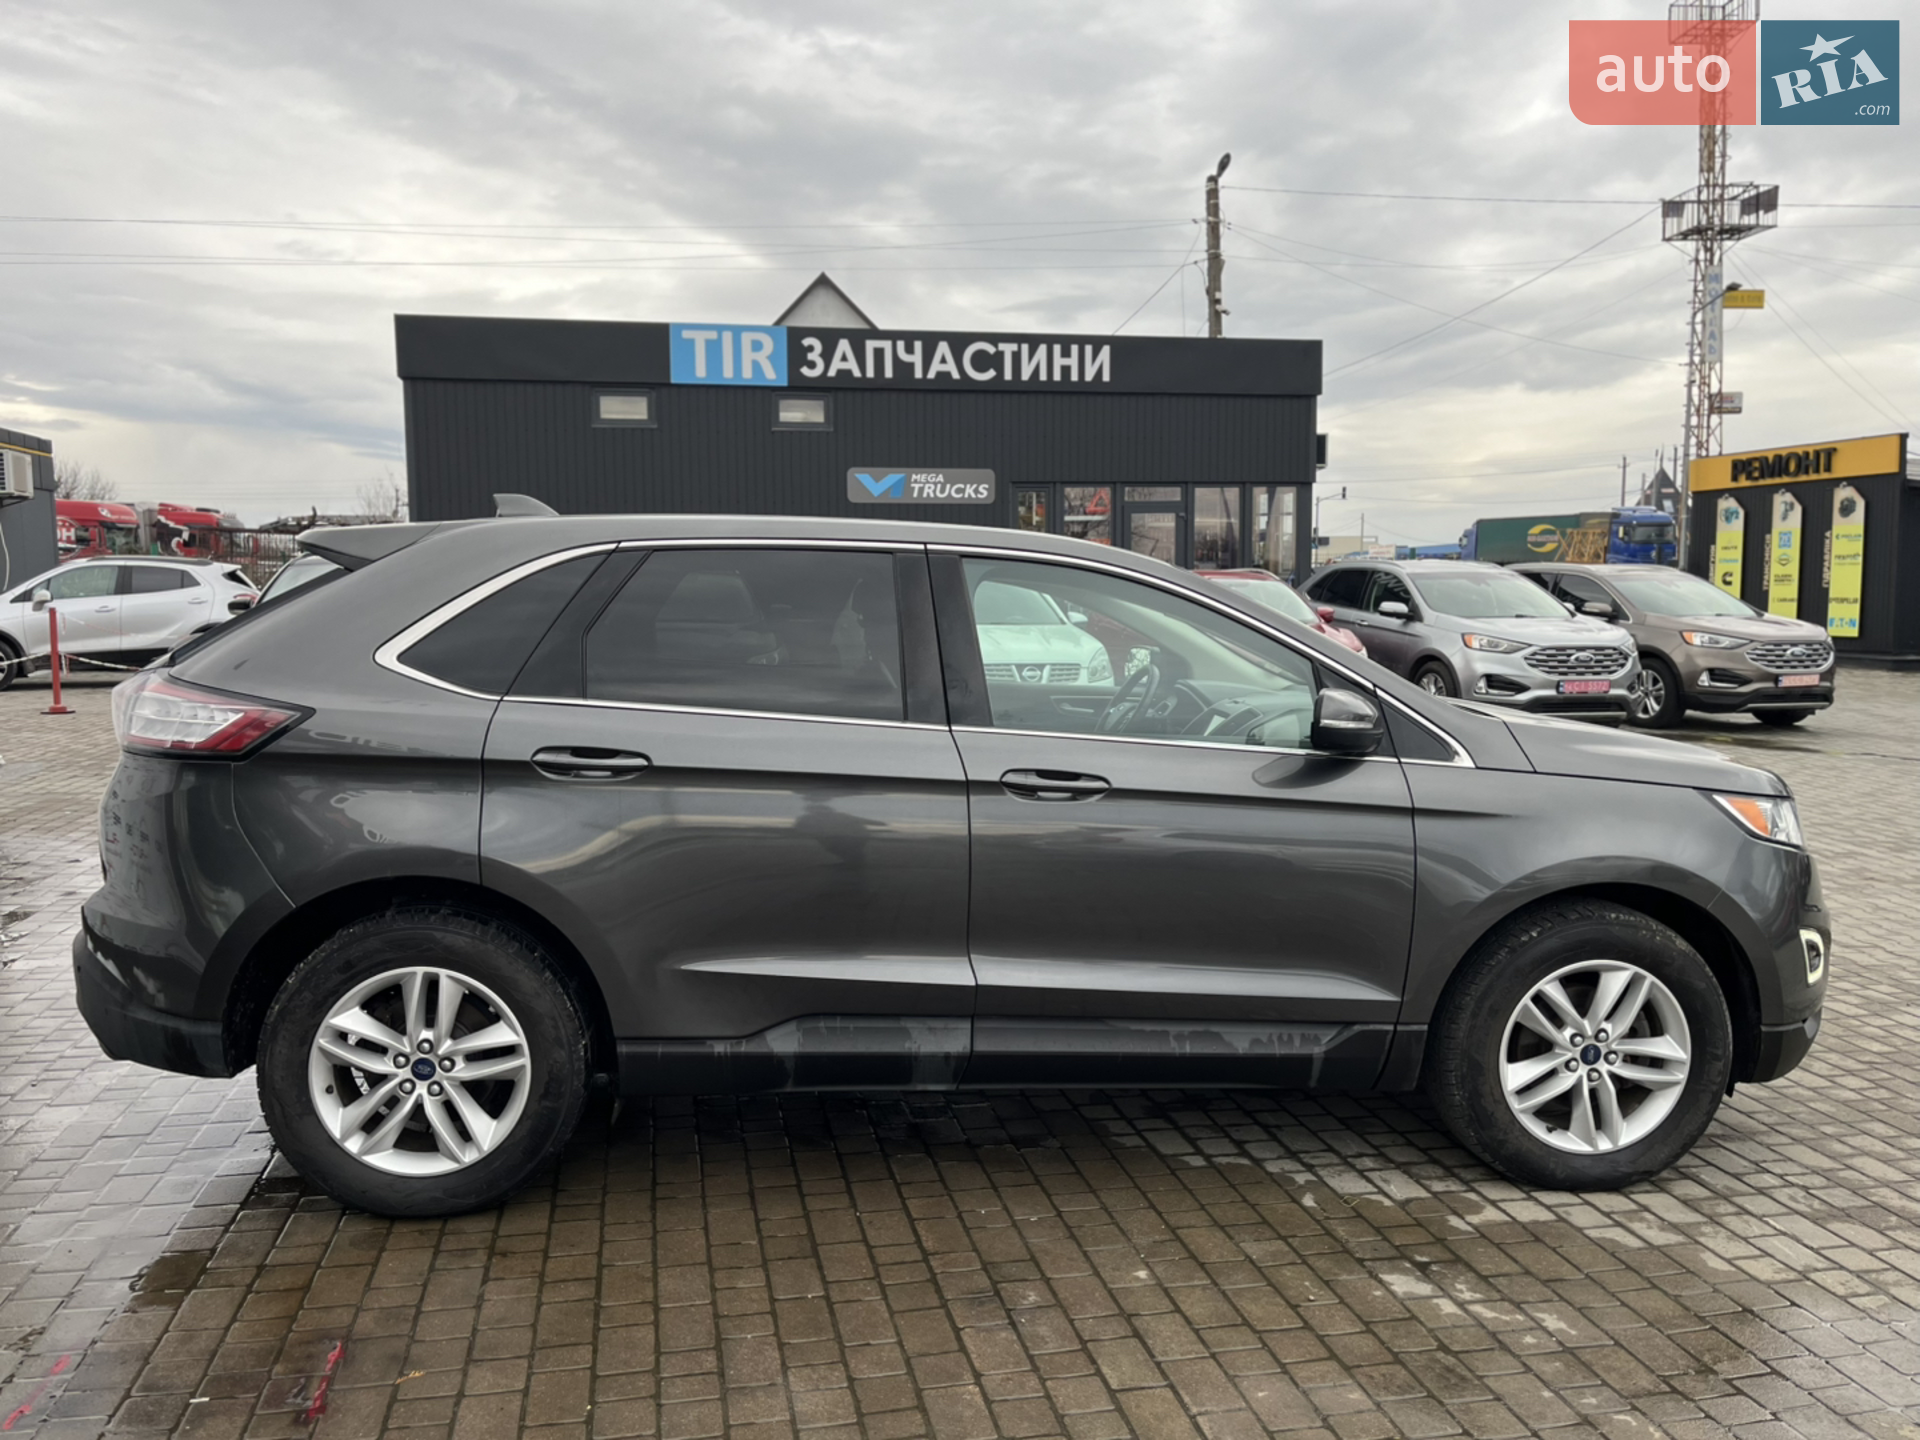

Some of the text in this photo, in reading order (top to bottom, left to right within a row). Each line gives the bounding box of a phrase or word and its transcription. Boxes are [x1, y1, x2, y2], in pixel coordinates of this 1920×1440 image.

[681, 330, 1111, 382] TIR ЗАПЧАСТИНИ
[911, 473, 944, 483] MEGA
[1730, 447, 1838, 483] РЕМОНТ
[910, 483, 989, 499] TRUCKS
